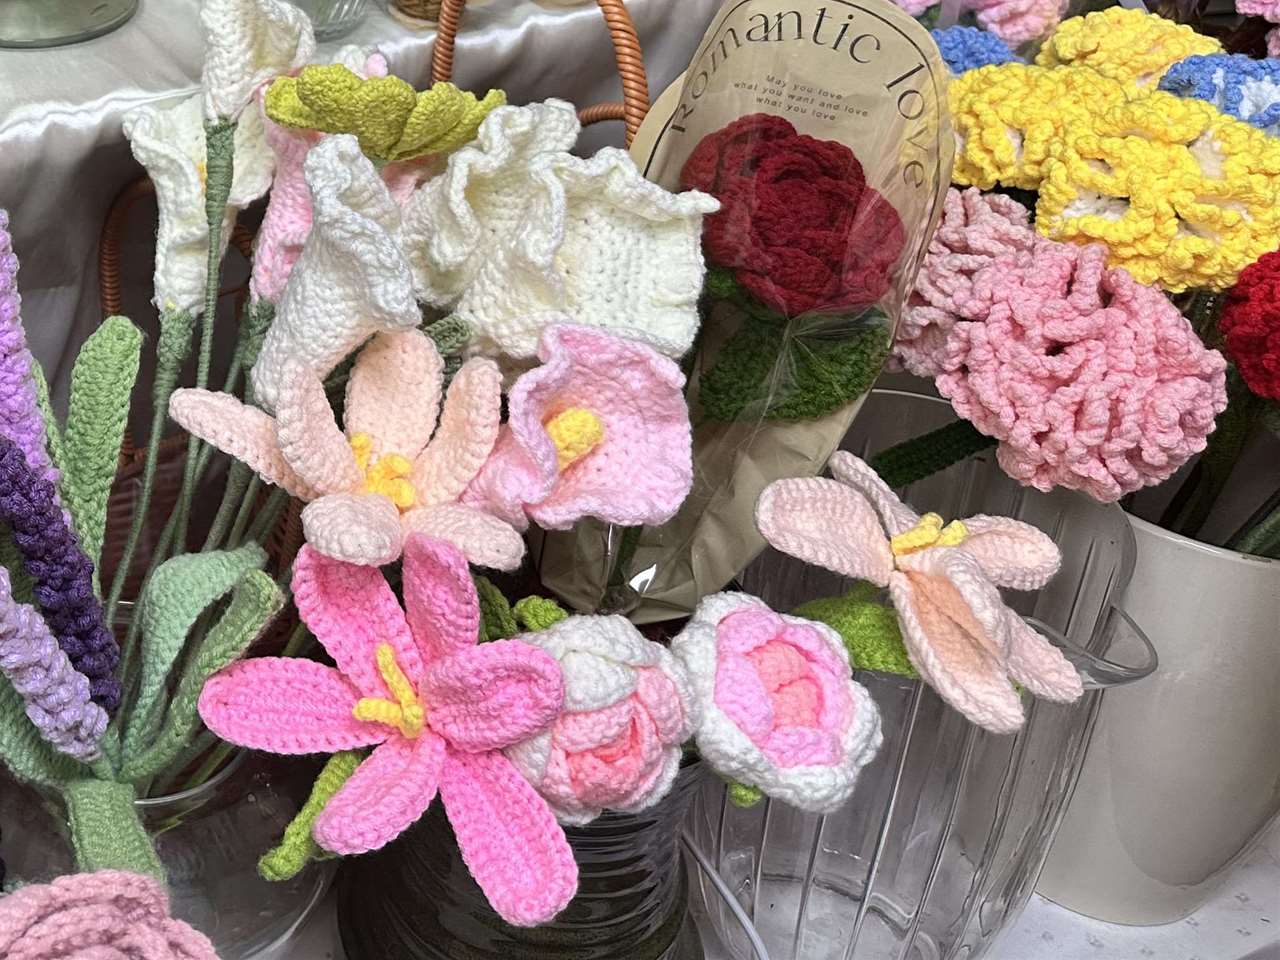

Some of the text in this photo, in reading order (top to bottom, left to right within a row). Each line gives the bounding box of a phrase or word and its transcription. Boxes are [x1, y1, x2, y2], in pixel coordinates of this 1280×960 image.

[734, 82, 869, 117] what you want and love
[766, 74, 843, 100] May you love
[756, 96, 836, 121] what you love
[885, 62, 930, 189] love
